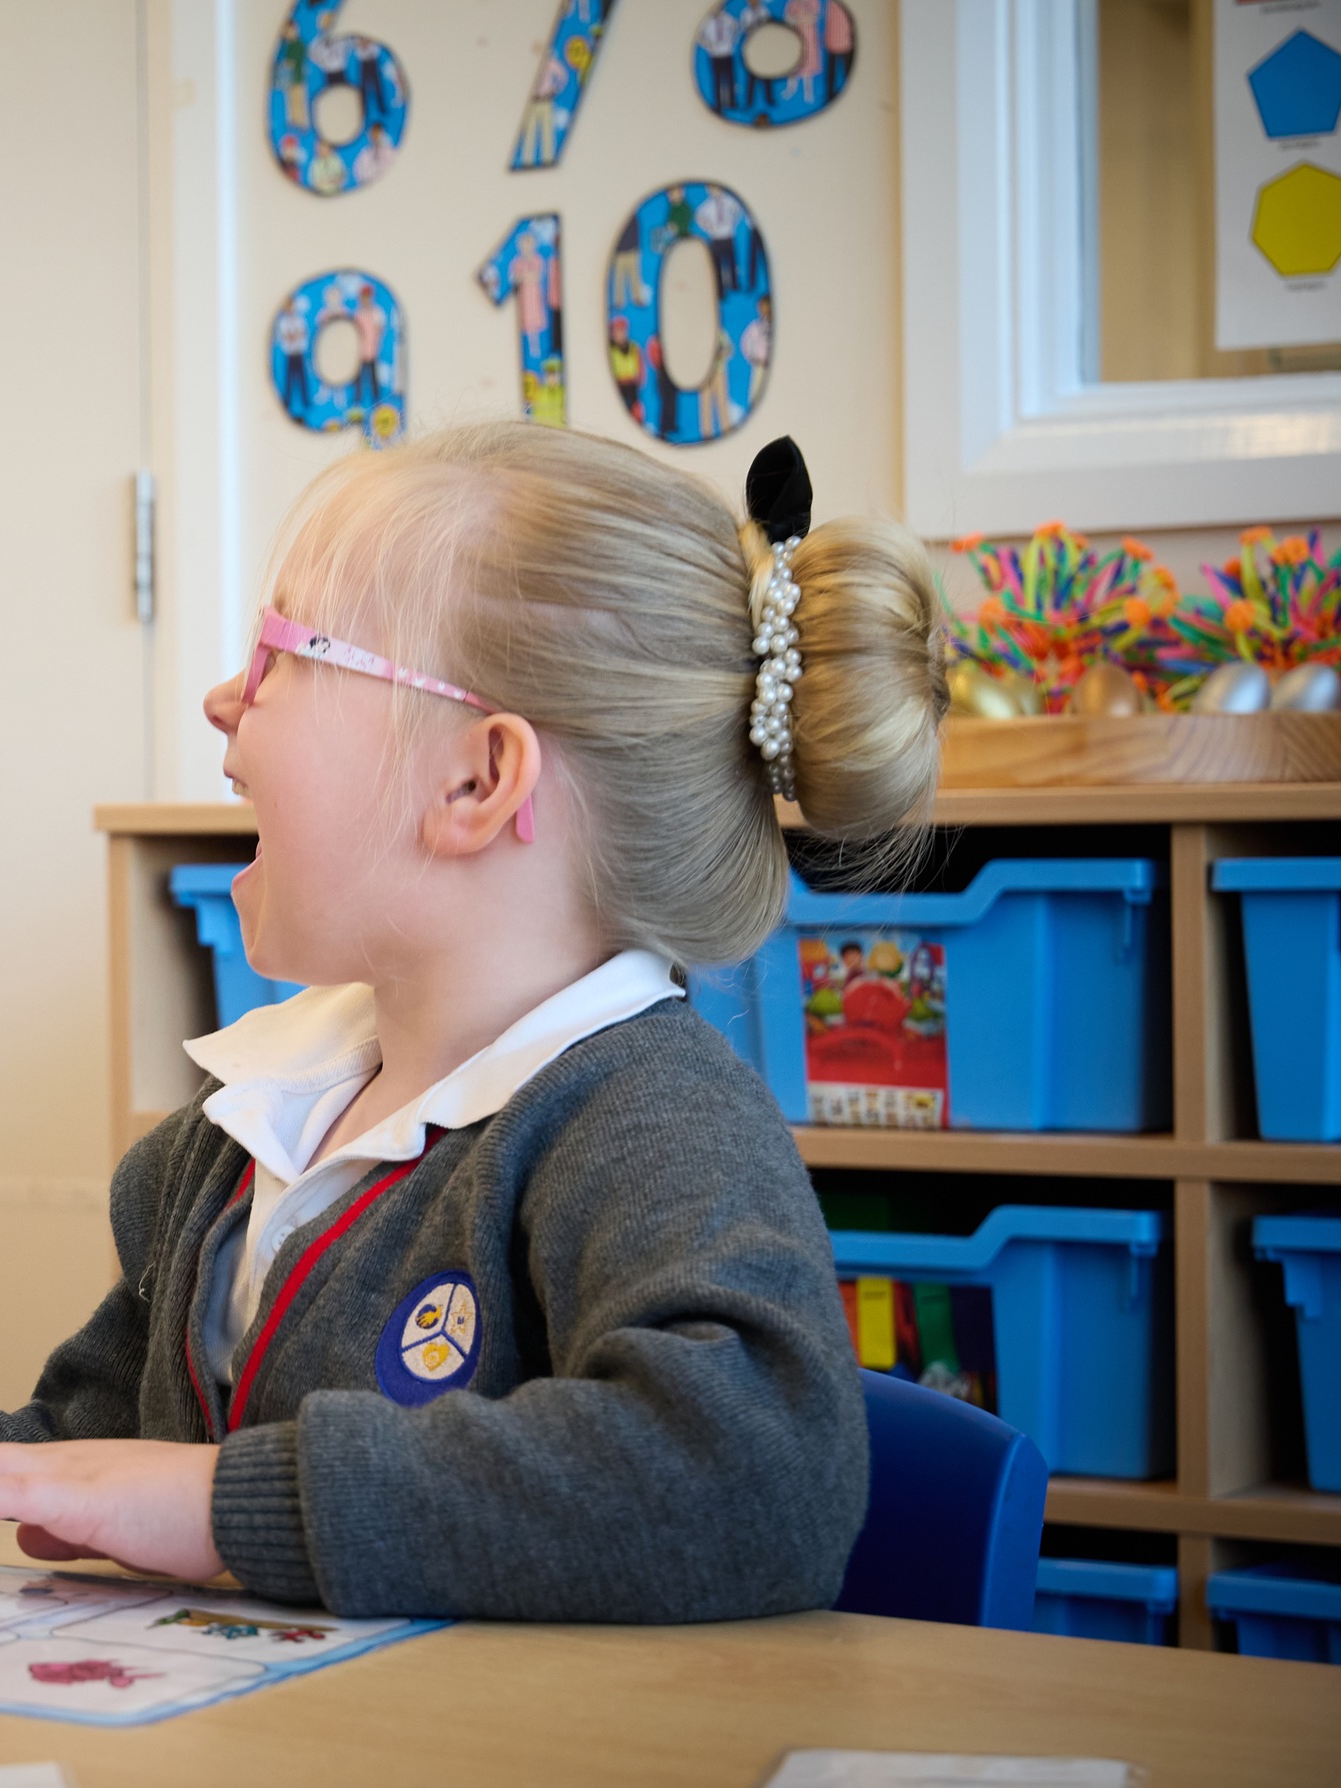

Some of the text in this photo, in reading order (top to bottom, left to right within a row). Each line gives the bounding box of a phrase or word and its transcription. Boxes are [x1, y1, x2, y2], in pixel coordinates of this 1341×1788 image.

[267, 0, 411, 196] 6
[269, 179, 775, 450] 9 10
